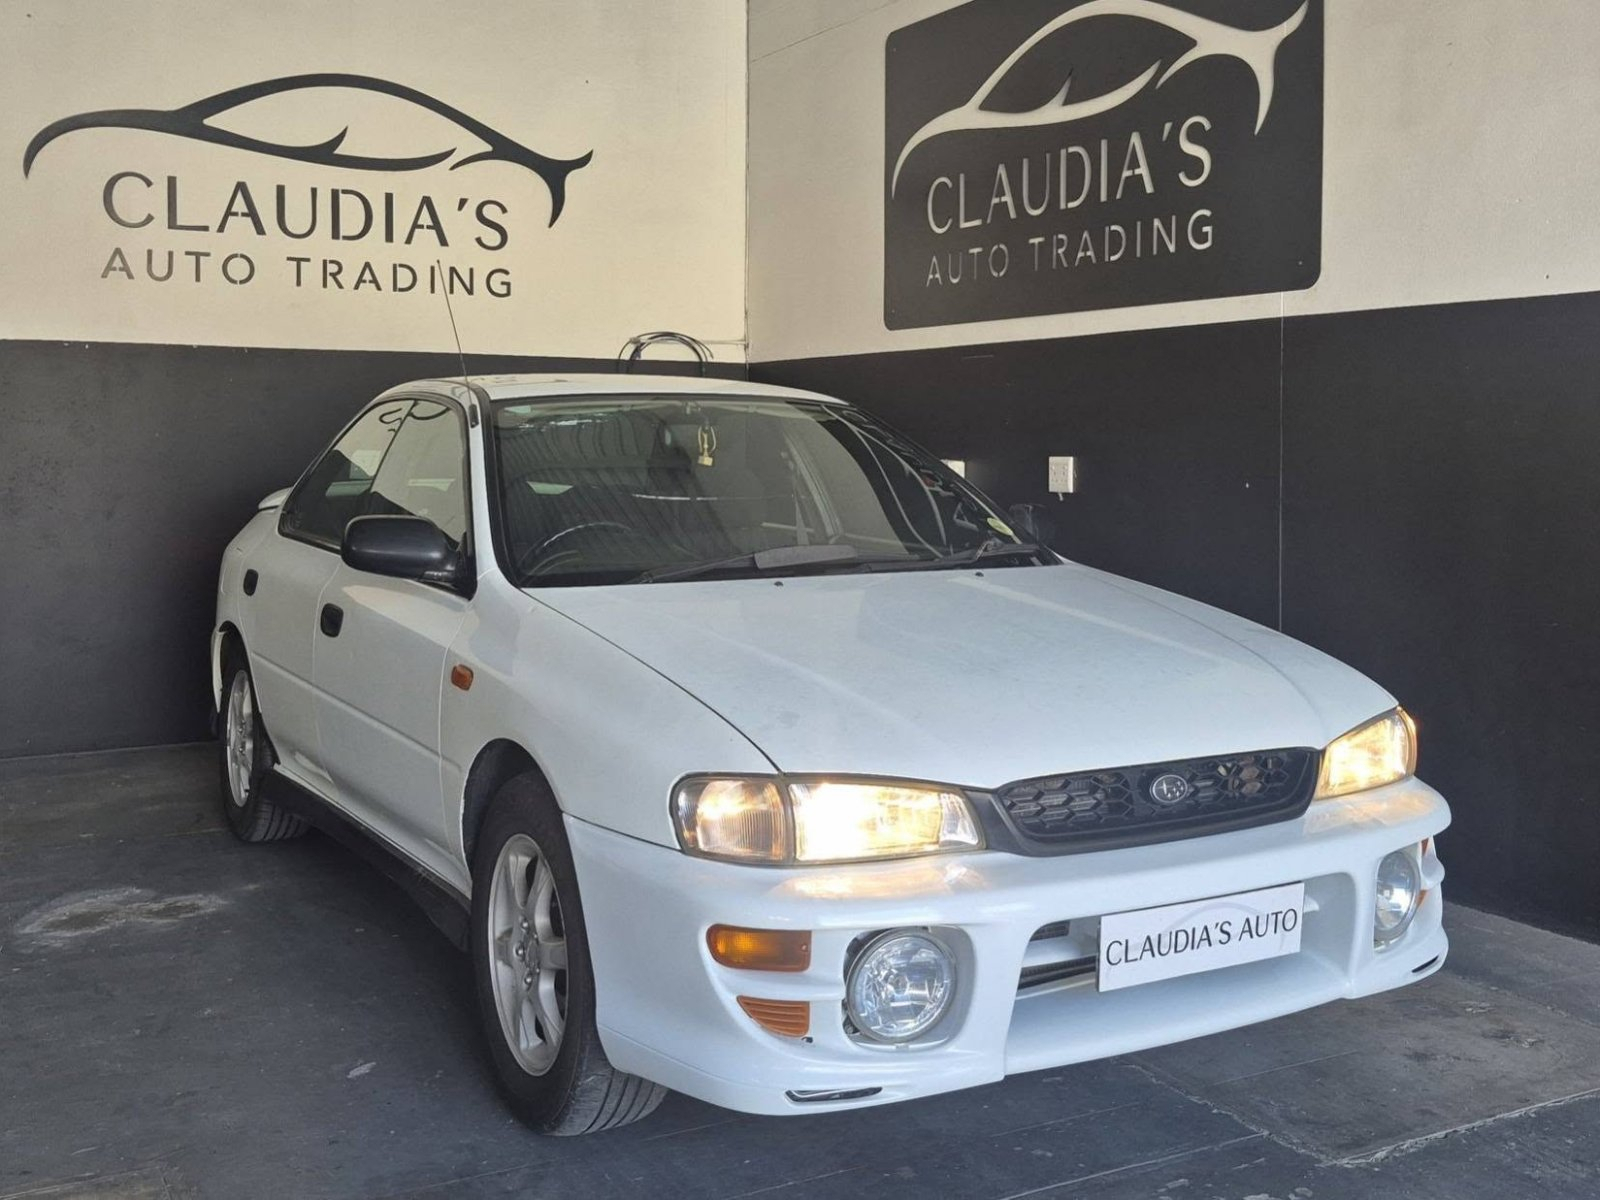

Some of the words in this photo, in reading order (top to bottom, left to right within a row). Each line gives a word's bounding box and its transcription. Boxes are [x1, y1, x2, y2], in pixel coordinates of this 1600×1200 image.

[102, 171, 509, 251] CLAUDIA'S
[927, 115, 1212, 234] CLAUDIA'S
[100, 247, 256, 286] AUTO
[286, 256, 512, 298] TRADING
[926, 243, 1009, 287] AUTO
[1028, 209, 1213, 272] TRADING
[1106, 920, 1232, 966] CLAUDIA'S
[1238, 908, 1298, 942] AUTO
